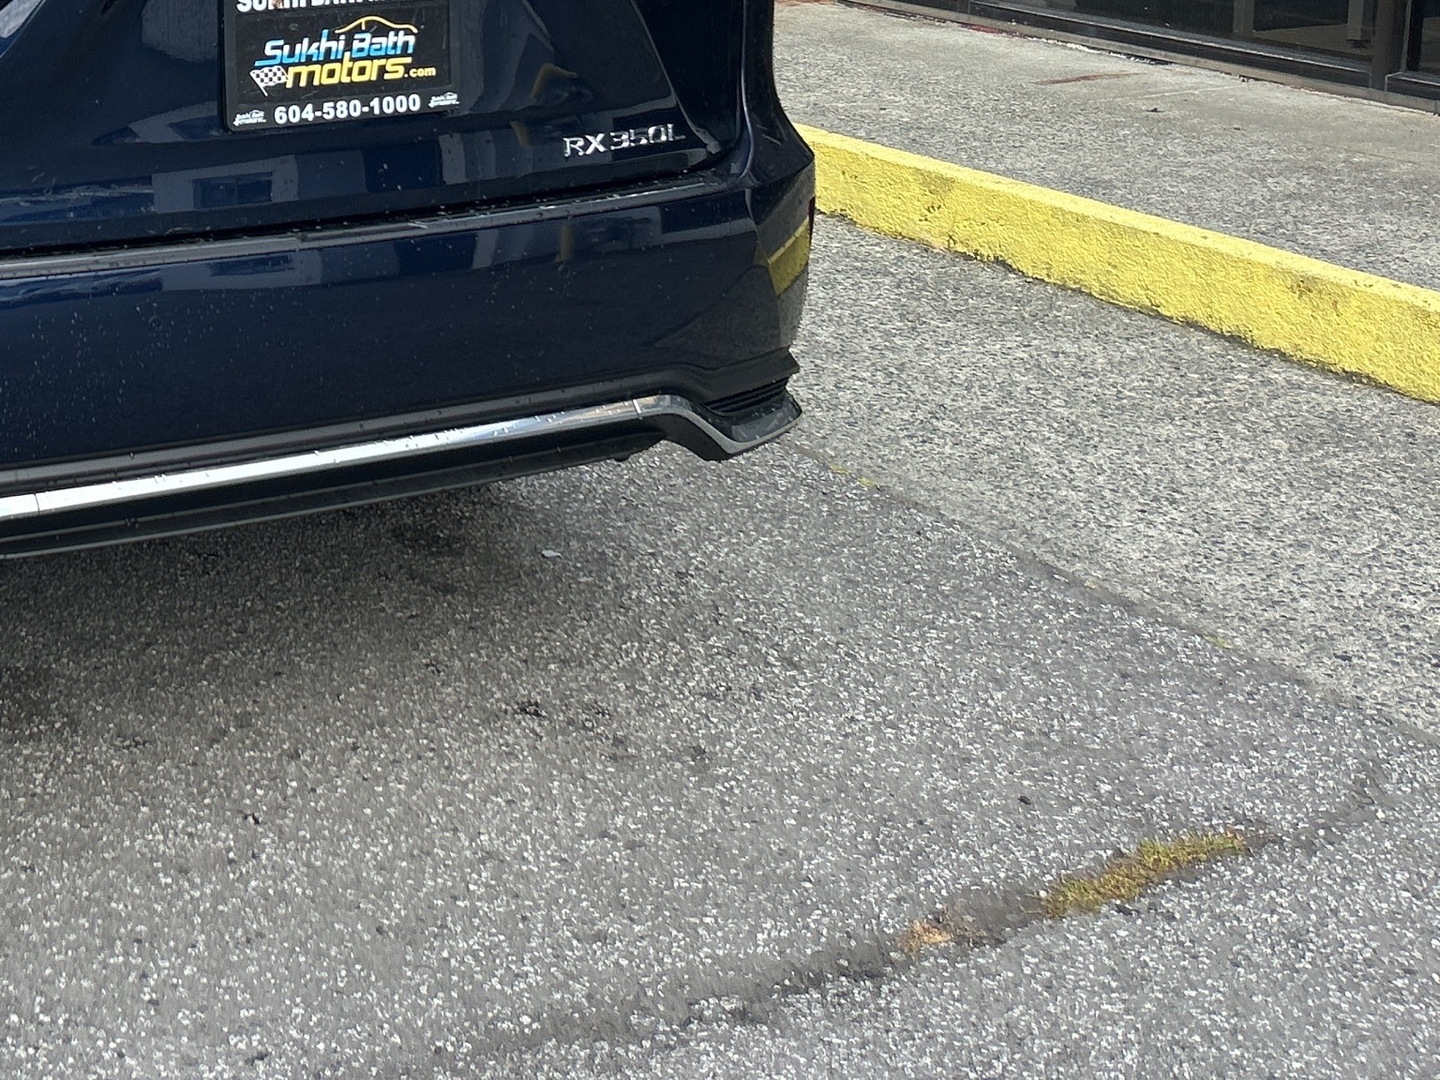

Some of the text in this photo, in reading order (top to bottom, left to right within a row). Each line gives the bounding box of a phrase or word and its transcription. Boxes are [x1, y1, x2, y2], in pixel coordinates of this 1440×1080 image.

[254, 29, 416, 67] Sukhi Bath
[274, 93, 422, 125] 604-580-1000
[563, 133, 608, 157] RX
